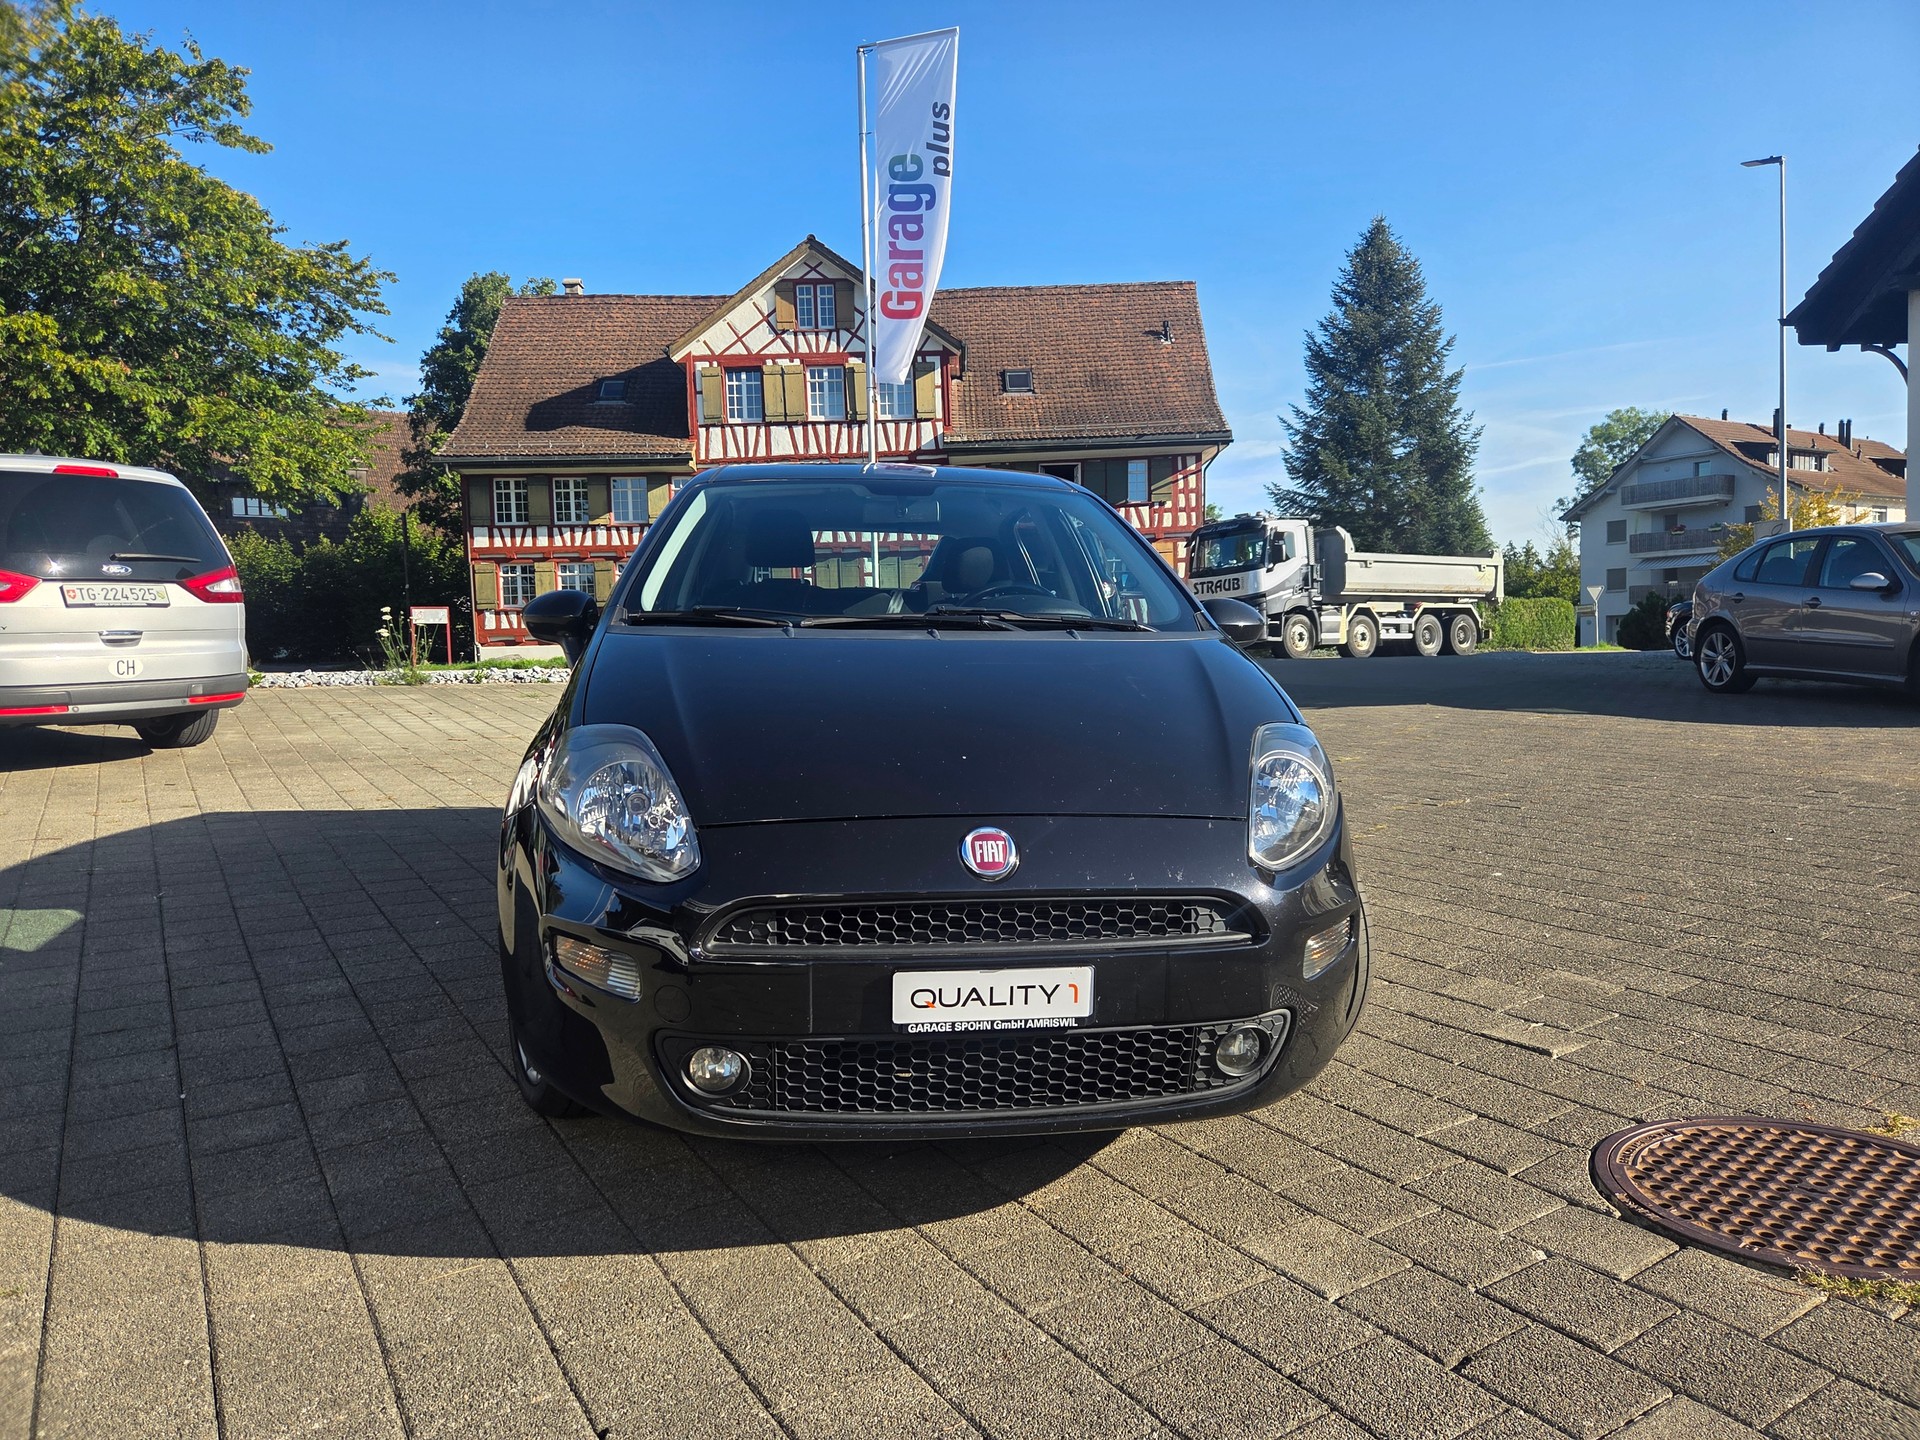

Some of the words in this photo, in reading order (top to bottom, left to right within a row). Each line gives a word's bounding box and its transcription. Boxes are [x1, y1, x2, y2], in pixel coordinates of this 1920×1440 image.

[926, 101, 951, 177] plus
[880, 153, 937, 320] Garage
[1193, 577, 1241, 595] STRAUB
[116, 659, 136, 676] CH
[974, 840, 1005, 863] FIAT
[910, 983, 1061, 1009] QUALITY
[1068, 983, 1079, 1003] 1
[908, 1022, 952, 1033] GARAGE
[954, 1020, 992, 1032] SPOHN
[993, 1019, 1026, 1031] GmbH
[1026, 1017, 1078, 1029] AMRISWIL
